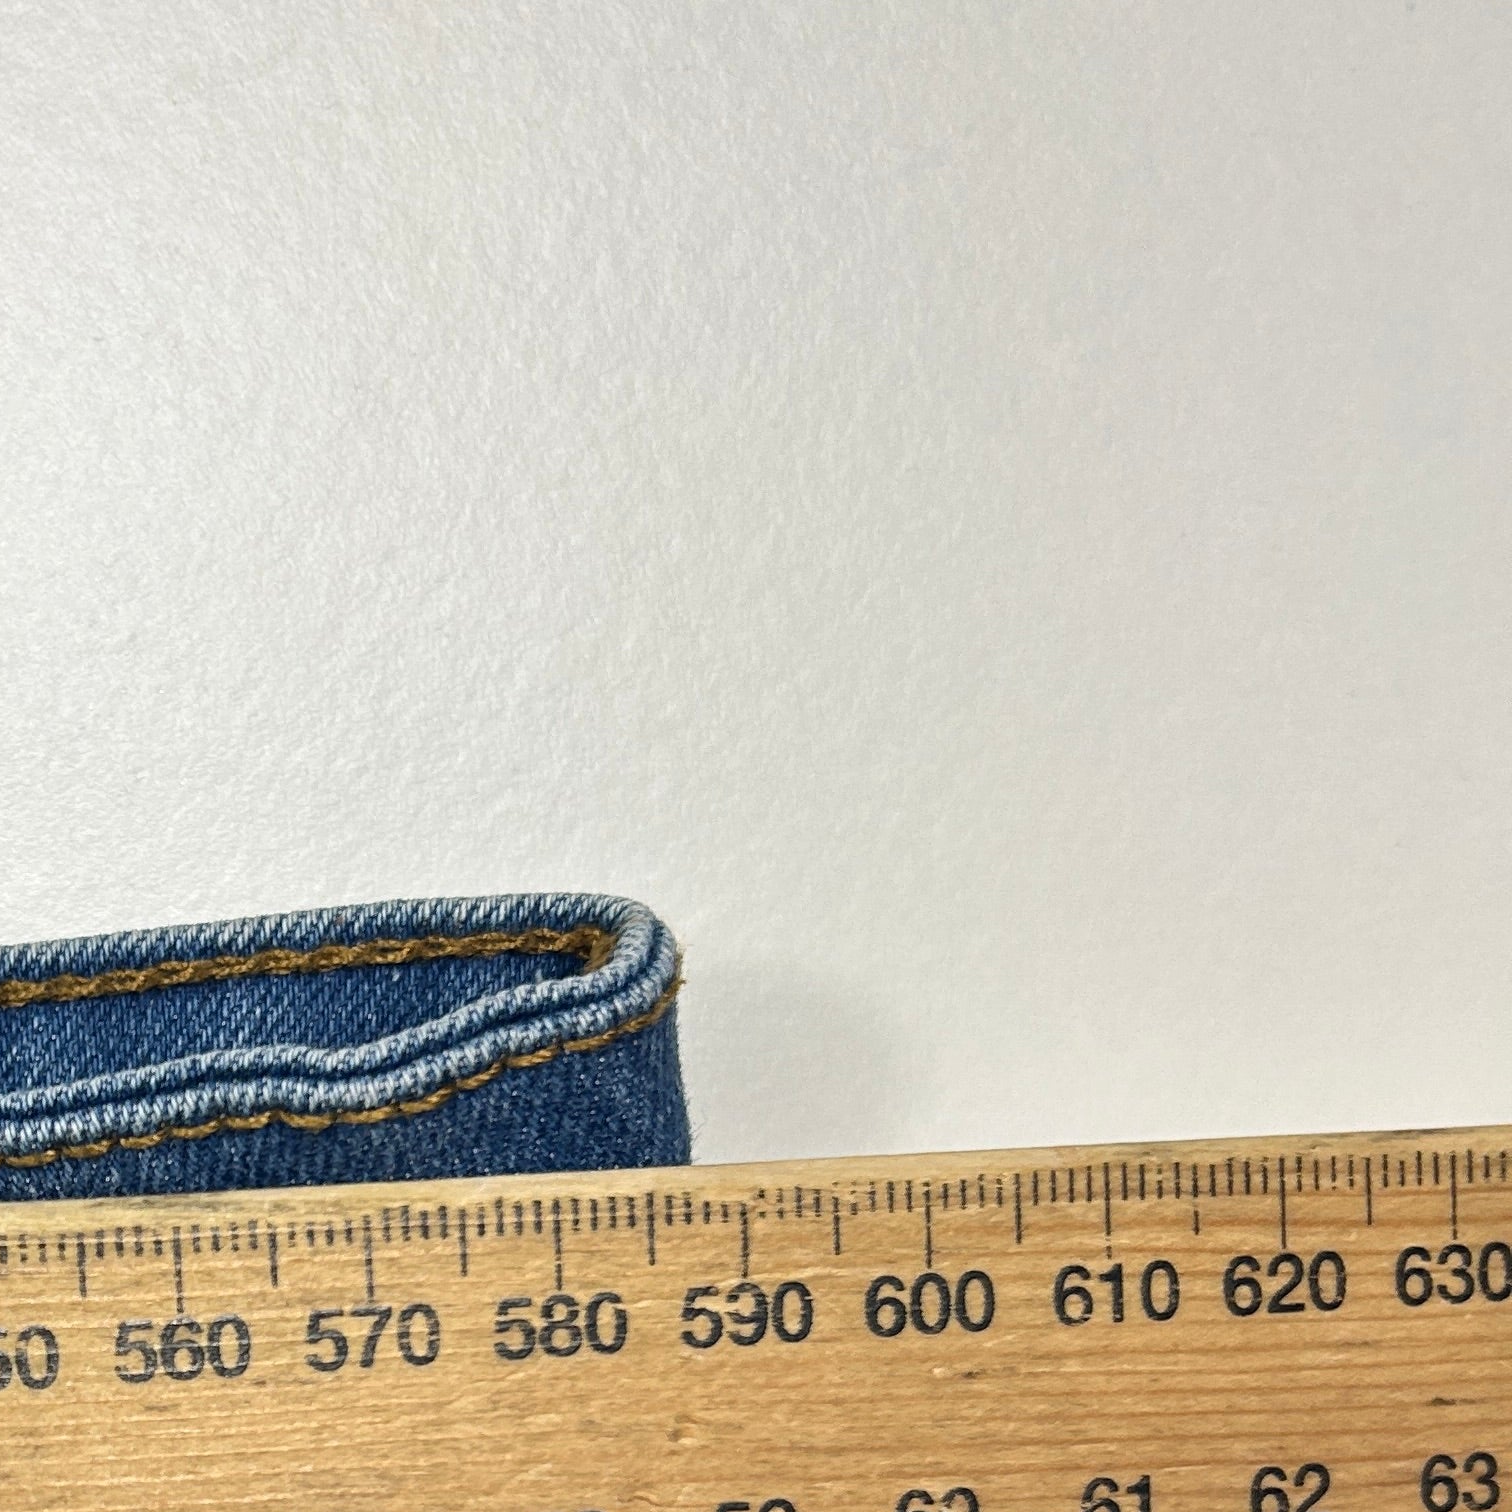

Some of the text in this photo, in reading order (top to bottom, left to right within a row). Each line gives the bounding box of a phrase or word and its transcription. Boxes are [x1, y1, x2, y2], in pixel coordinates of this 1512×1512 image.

[114, 1316, 251, 1384] 560
[303, 1303, 440, 1373] 570
[494, 1292, 628, 1362] 580
[680, 1281, 814, 1350] 590
[864, 1270, 995, 1339] 600
[1053, 1260, 1180, 1327] 610
[1223, 1250, 1347, 1317] 620
